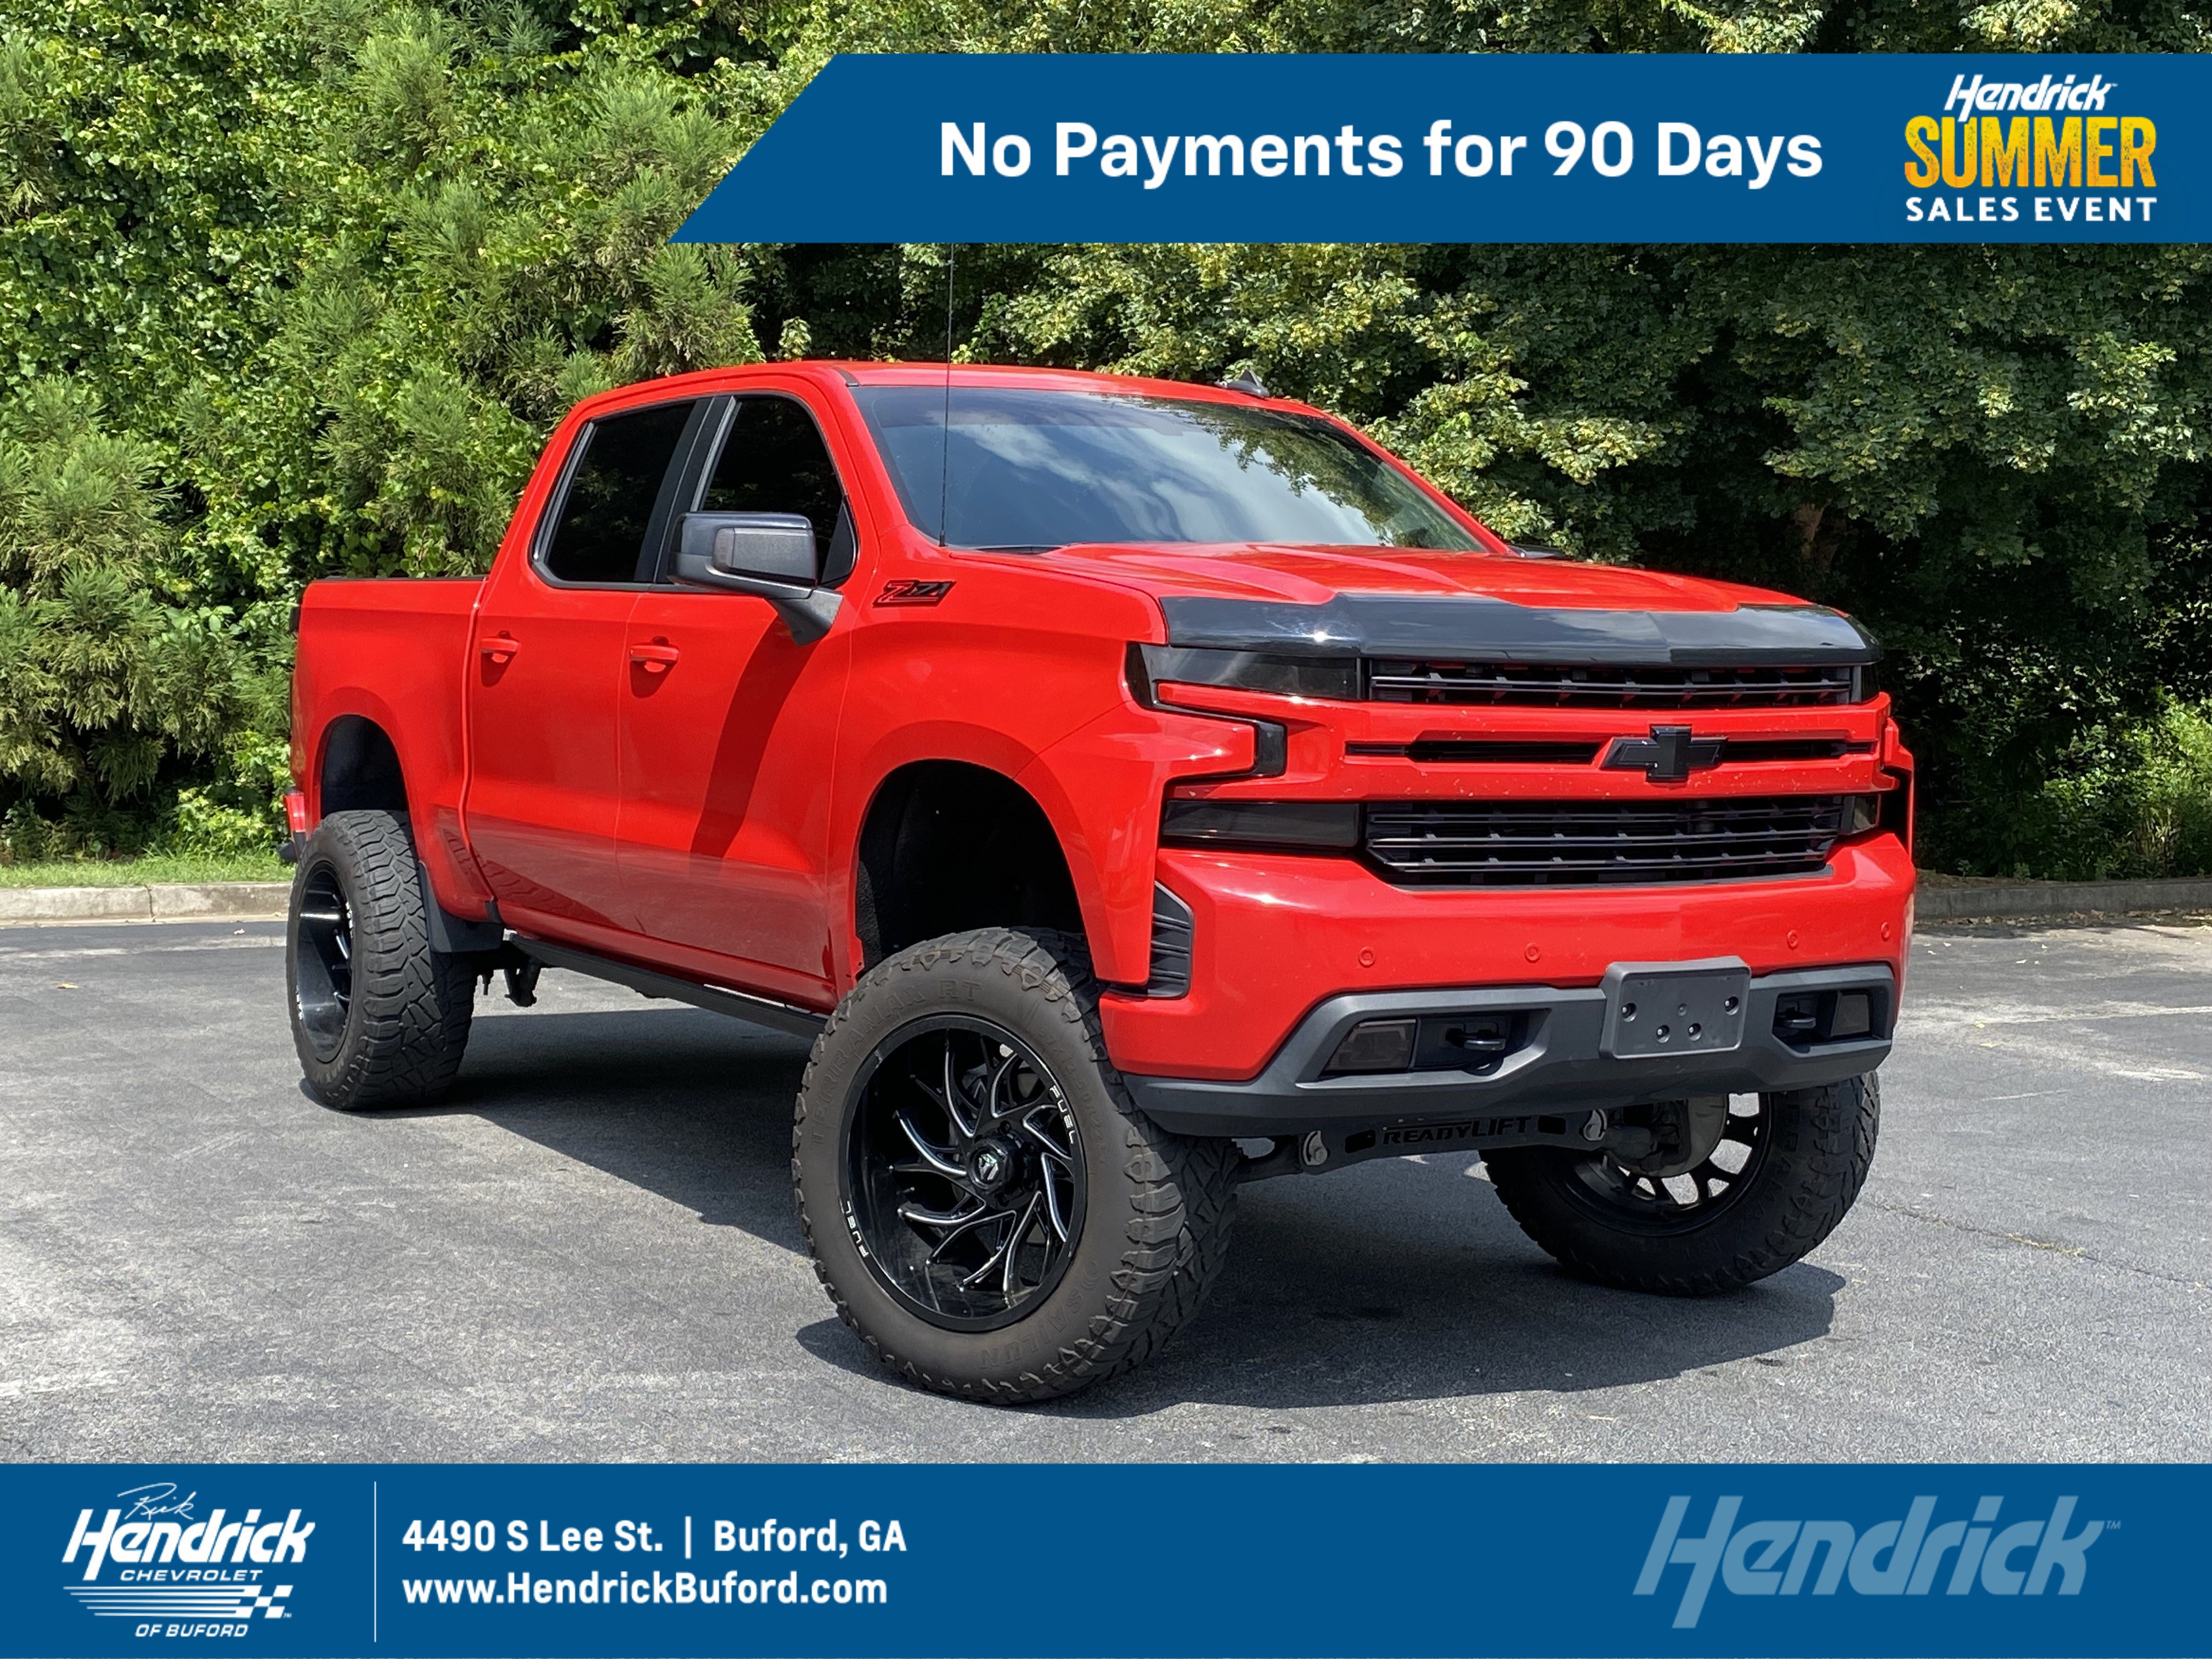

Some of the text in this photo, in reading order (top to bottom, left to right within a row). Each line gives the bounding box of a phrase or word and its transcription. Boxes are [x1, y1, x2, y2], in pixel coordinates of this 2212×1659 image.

[1049, 1085, 1075, 1144] FUEL
[1383, 1115, 1533, 1145] READYLIFT
[845, 1200, 869, 1257] FUEL
